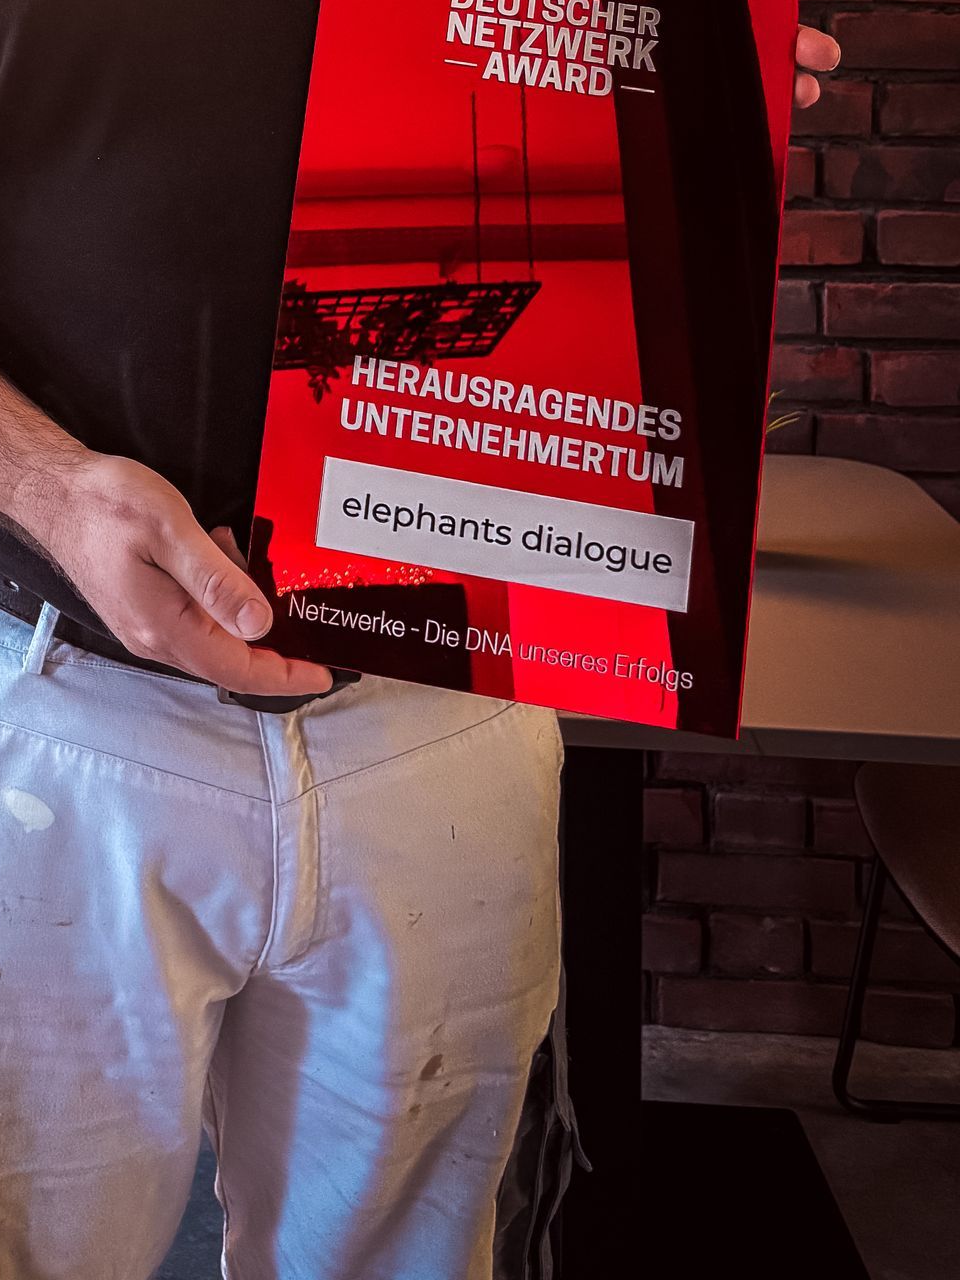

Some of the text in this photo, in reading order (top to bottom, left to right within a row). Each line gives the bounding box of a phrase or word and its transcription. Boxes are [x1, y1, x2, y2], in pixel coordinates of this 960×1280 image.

[446, 11, 660, 72] NETZWERK
[482, 51, 613, 96] AWARD
[351, 355, 682, 441] HERAUSRAGENDES
[340, 398, 685, 488] UNTERNEHMERTUM
[342, 493, 673, 573] elephants dialogue
[288, 593, 406, 638] Netzwerke
[425, 619, 460, 648] Die
[465, 627, 513, 658] DNA
[519, 642, 608, 674] unseres
[614, 653, 693, 691] Erfolgs
